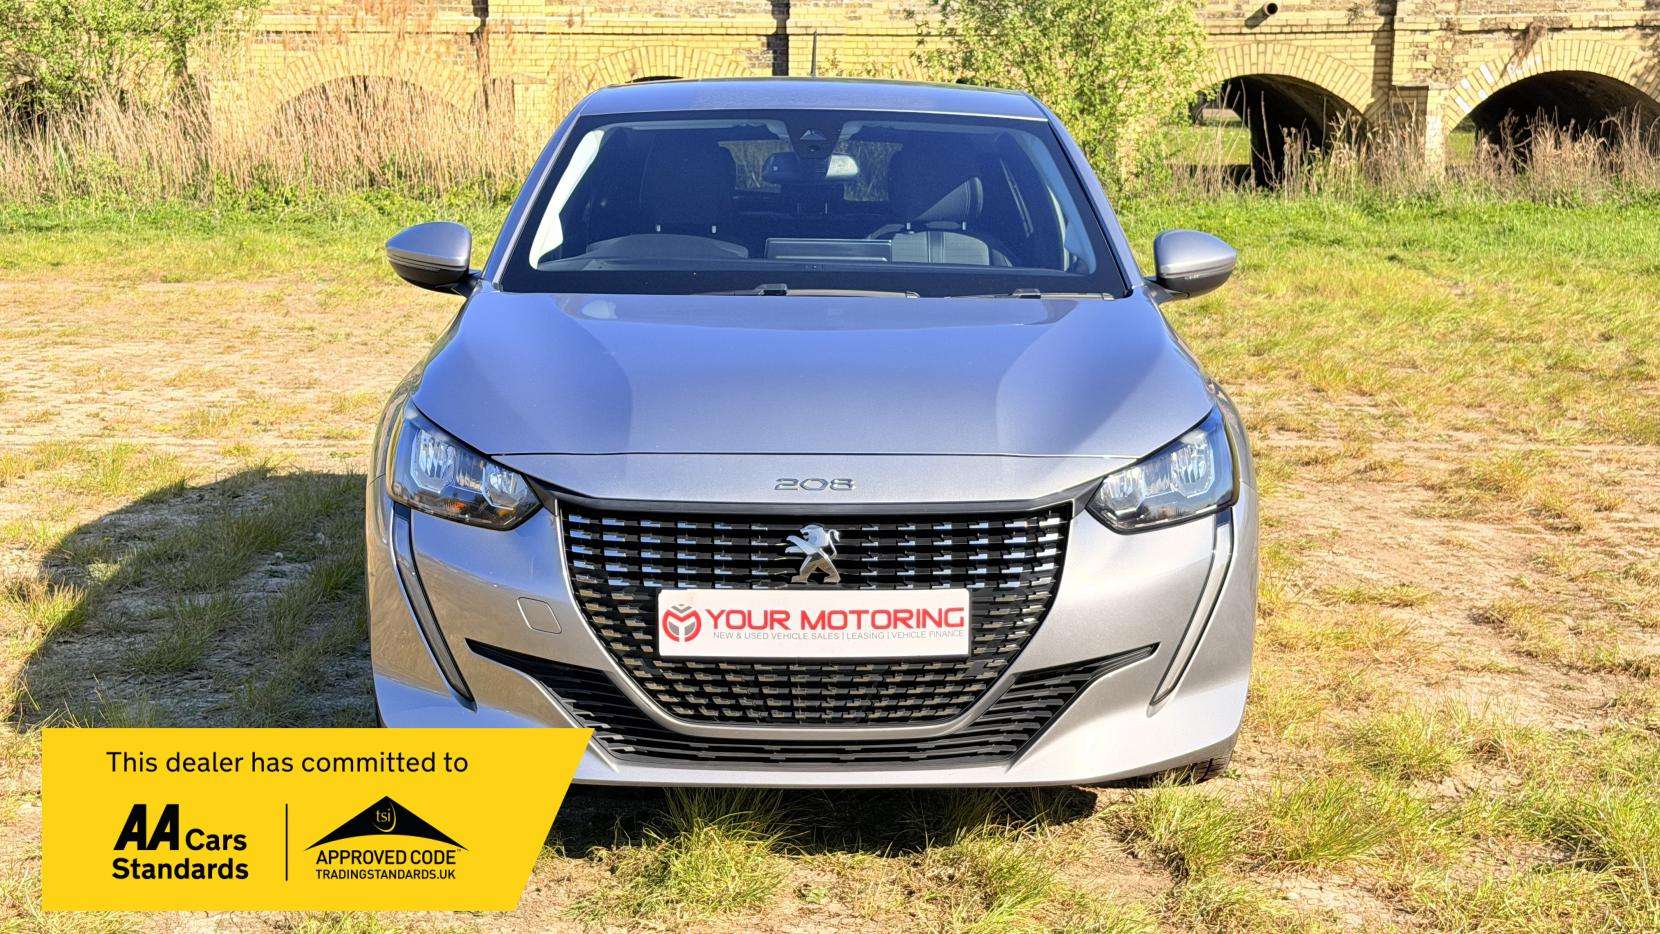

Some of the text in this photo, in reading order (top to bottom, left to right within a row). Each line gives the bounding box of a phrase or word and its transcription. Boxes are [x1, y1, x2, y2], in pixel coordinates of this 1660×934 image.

[775, 478, 855, 491] 208
[705, 607, 965, 630] YOUR MOTORING
[713, 631, 734, 640] NEW
[744, 631, 769, 640] USED
[771, 631, 808, 640] VEHICLE
[811, 631, 839, 640] SALES
[847, 631, 885, 640] LEASING
[892, 630, 926, 639] VEHICLE
[929, 630, 965, 638] FINANCE
